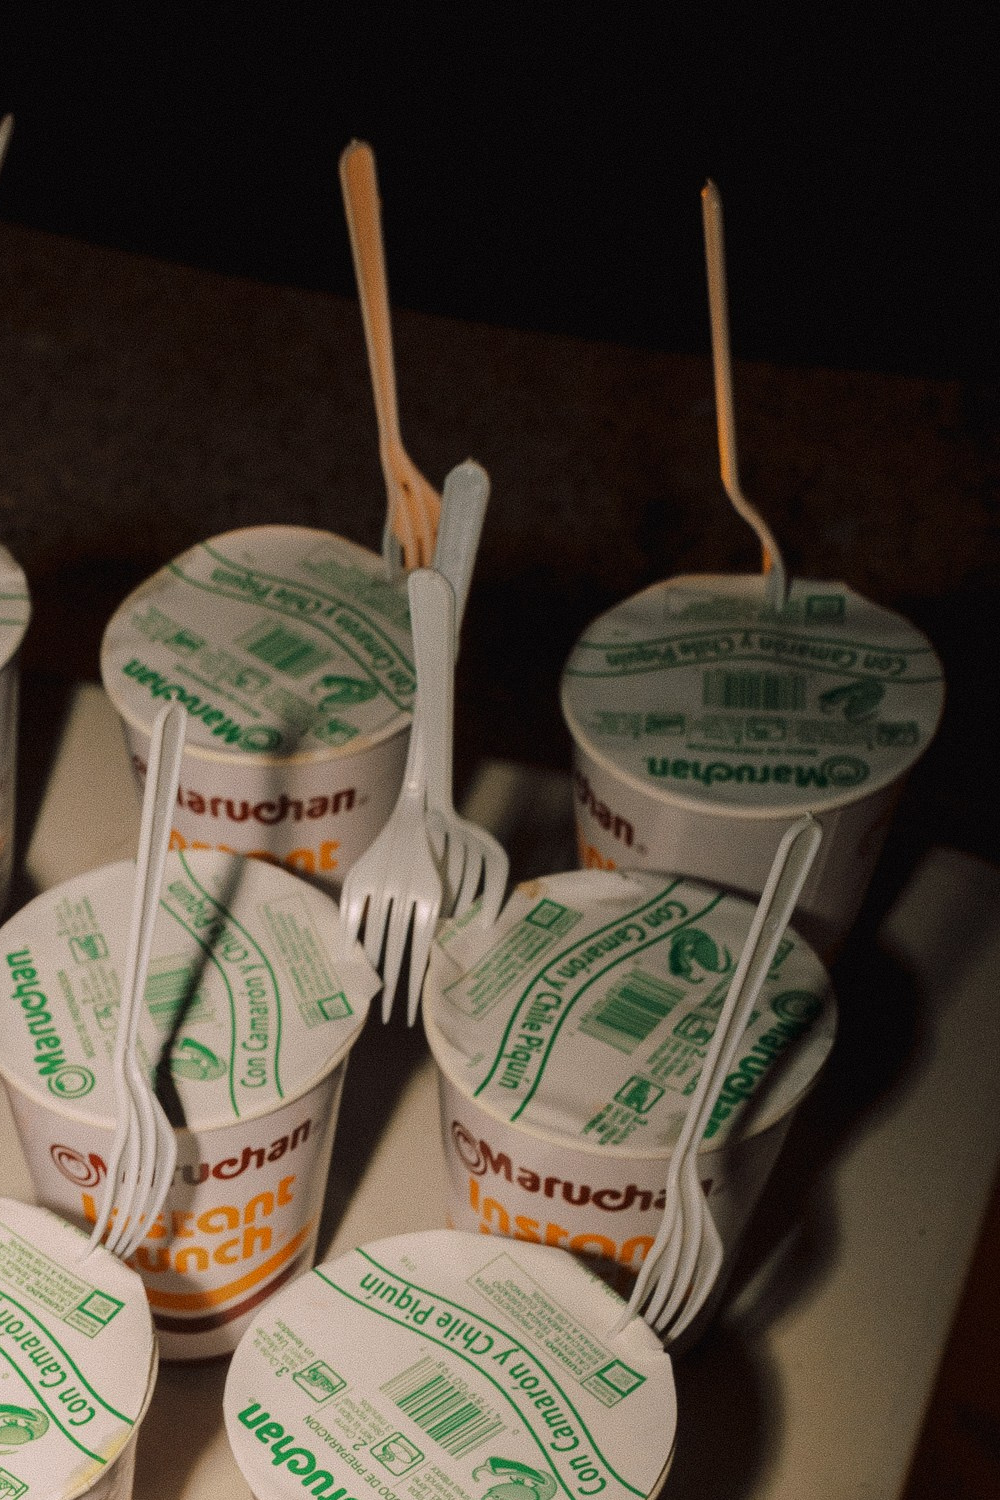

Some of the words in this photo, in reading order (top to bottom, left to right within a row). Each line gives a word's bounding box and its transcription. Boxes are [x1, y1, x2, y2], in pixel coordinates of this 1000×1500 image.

[648, 756, 831, 788] Maruchan
[643, 899, 689, 930] Con
[567, 921, 645, 984] Camarón
[5, 947, 67, 1077] Maruchan
[527, 991, 562, 1034] Chile
[499, 1029, 543, 1090] Piquín
[360, 1271, 428, 1326] Piquín
[436, 1310, 494, 1356] Chile
[493, 1347, 519, 1366] y
[57, 1385, 96, 1427] Con
[509, 1360, 573, 1453] Camarón
[566, 1450, 607, 1497] Con
